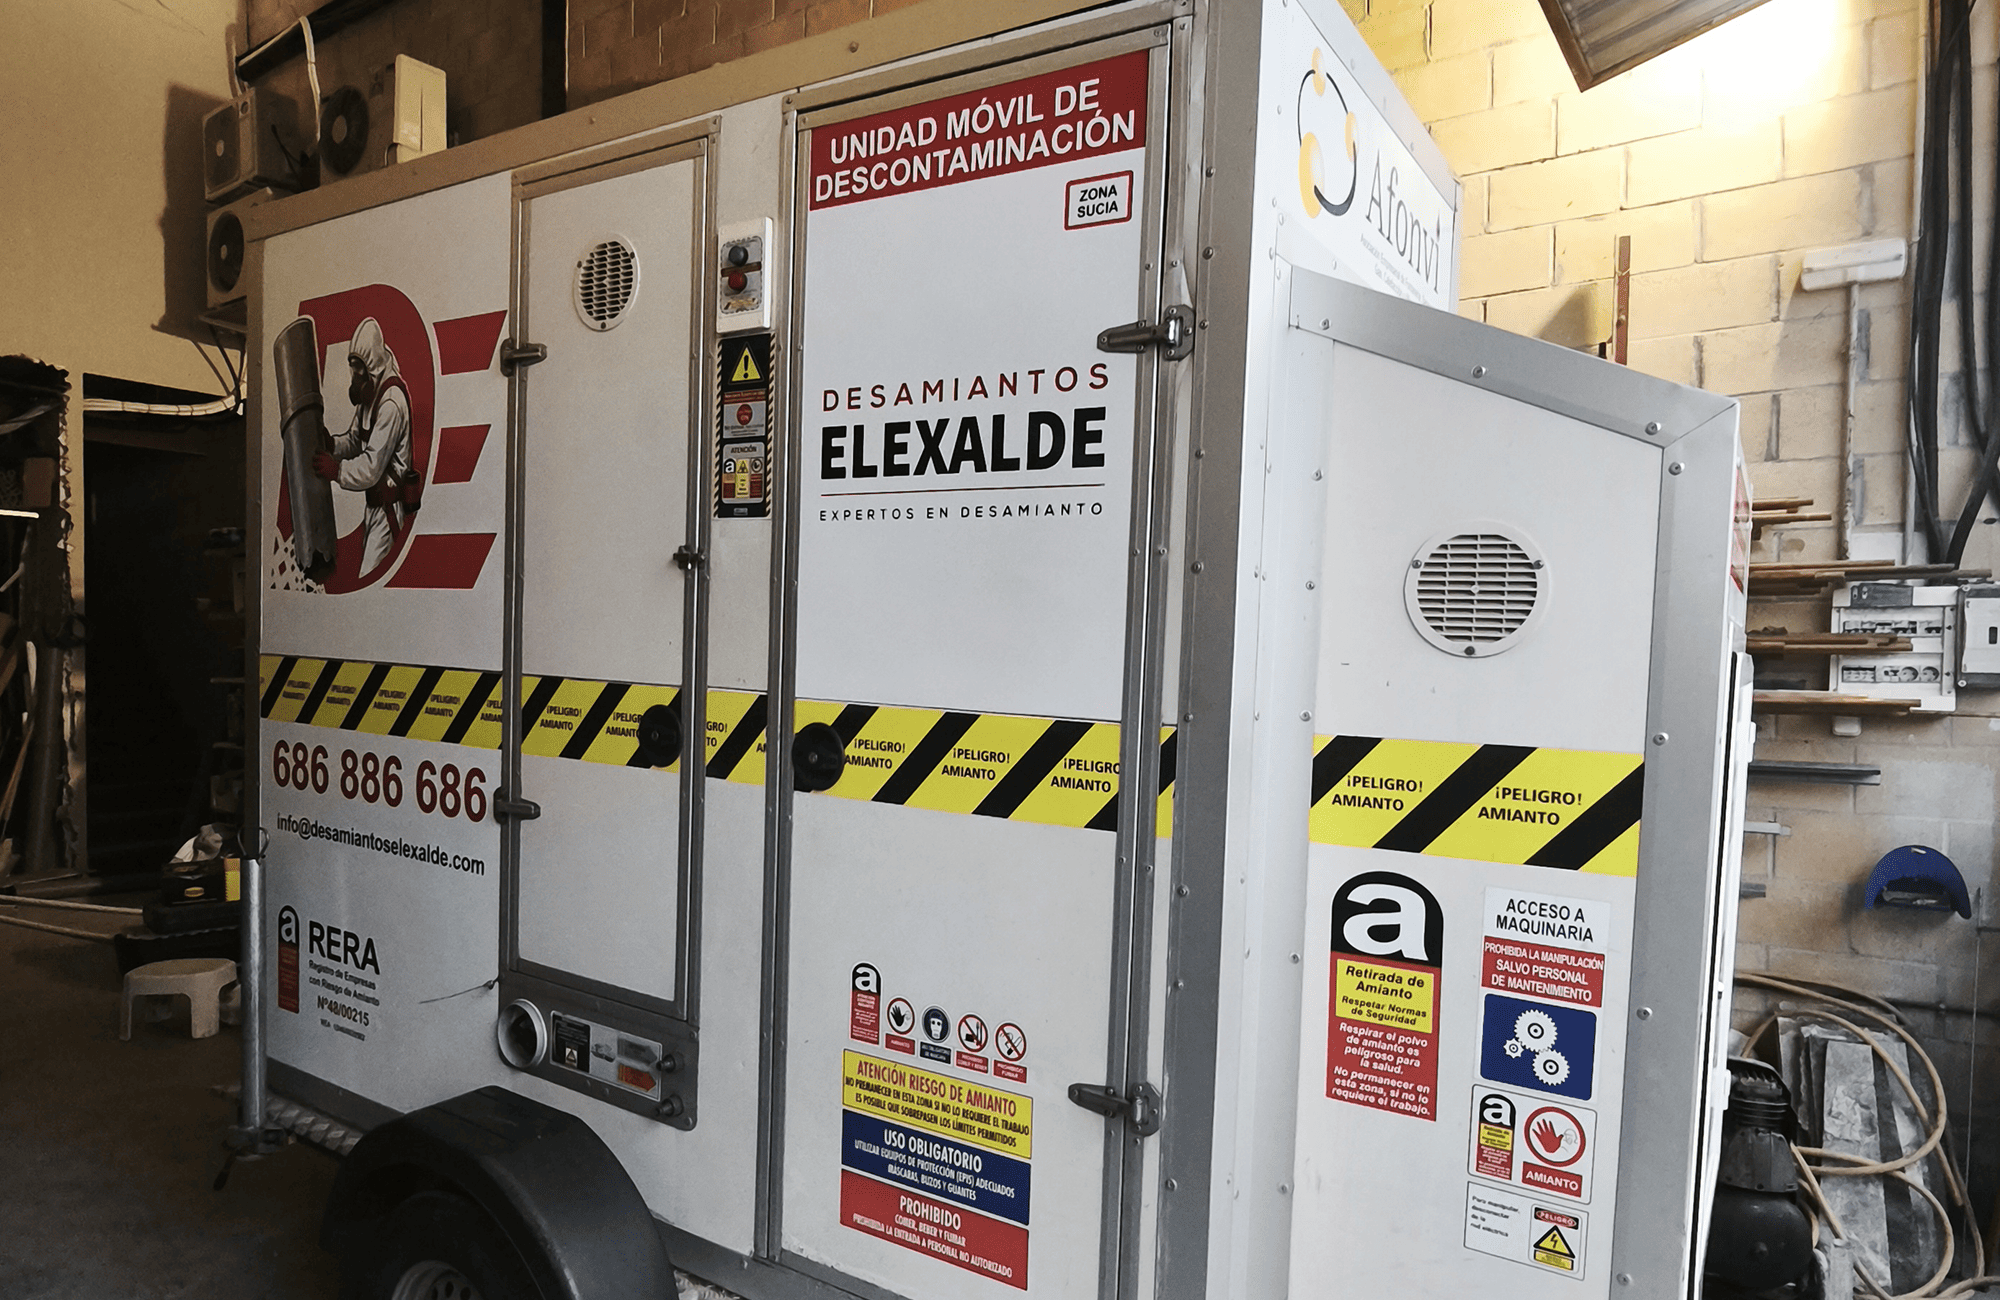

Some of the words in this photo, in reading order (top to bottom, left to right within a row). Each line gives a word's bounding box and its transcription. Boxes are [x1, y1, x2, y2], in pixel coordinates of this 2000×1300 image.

[831, 117, 937, 164] UNIDAD
[947, 94, 1044, 140] MÓVIL
[1055, 78, 1100, 117] DE
[815, 109, 1135, 202] DESCONTAMINACIÓN
[1079, 185, 1118, 202] ZONA
[1077, 201, 1118, 218] SUCIA
[1365, 149, 1440, 294] Afonvi
[823, 363, 1109, 412] DESAMIANTOS
[821, 406, 1106, 479] ELEXALDE
[820, 507, 914, 521] EXPERTOS
[926, 506, 949, 519] EN
[961, 502, 1103, 518] DESAMIANTO
[546, 706, 582, 717] ¡PELIGRO!
[612, 711, 642, 723] ¡PELIGR
[540, 719, 573, 731] AMIANTO
[854, 738, 906, 753] ¡PELIGRO!
[952, 747, 1010, 764] ¡PELIGRO!
[845, 754, 892, 769] AMIANTO
[941, 764, 996, 781] AMIANTO
[1063, 758, 1120, 774] ¡PELIGRO
[273, 739, 329, 794] 686
[340, 749, 403, 807] 886
[416, 760, 487, 822] 686
[1050, 776, 1111, 793] AMIANTO
[1347, 775, 1423, 793] ¡PELIGRO!
[1331, 793, 1404, 811] AMIANTO
[1495, 786, 1582, 806] ¡PELIGRO!
[1477, 806, 1560, 826] AMIANTO
[277, 812, 485, 876] info@desamiantoselexalde.com
[1343, 883, 1429, 961] a
[1506, 898, 1571, 921] ACCESO
[1574, 908, 1585, 923] A
[1496, 914, 1594, 943] MAQUINARIA
[309, 920, 380, 975] RERA
[1484, 941, 1528, 959] PROHIBIDA
[1528, 948, 1540, 961] LA
[1541, 951, 1604, 971] MANIPULACIÓN
[855, 967, 878, 993] a
[1346, 965, 1403, 984] Retirada
[1407, 976, 1424, 988] de
[1496, 958, 1530, 975] SALVO
[1532, 964, 1589, 985] PERSONAL
[1356, 980, 1412, 1000] Amianto
[1491, 973, 1505, 987] DE
[1507, 976, 1592, 1002] MANTENIMIENTO
[1342, 995, 1385, 1010] Respetar
[1388, 1003, 1427, 1017] Normas
[1351, 1007, 1363, 1016] de
[1366, 1009, 1417, 1025] Seguridad
[1340, 1022, 1384, 1038] Respirar
[1386, 1032, 1396, 1041] el
[1398, 1035, 1428, 1047] polvo
[1346, 1035, 1359, 1045] de
[1362, 1039, 1404, 1053] amianto
[1406, 1047, 1420, 1056] es
[1344, 1046, 1394, 1061] peligroso
[1396, 1056, 1420, 1067] para
[1360, 1058, 1369, 1067] la
[1372, 1062, 1403, 1074] salud.
[857, 1060, 906, 1087] ATENCIÓN
[909, 1073, 946, 1098] RIESGO
[950, 1084, 963, 1103] DE
[966, 1089, 1016, 1117] AMIANTO
[1334, 1065, 1348, 1076] No
[1350, 1070, 1414, 1090] permanecer
[1416, 1084, 1430, 1094] en
[1334, 1078, 1357, 1088] esta
[1359, 1083, 1386, 1096] zona,
[1389, 1089, 1399, 1098] si
[1401, 1091, 1415, 1101] no
[1418, 1094, 1429, 1104] lo
[846, 1076, 854, 1086] NO
[893, 1089, 900, 1099] EN
[902, 1092, 914, 1104] ESTA
[916, 1096, 933, 1109] ZONA
[934, 1101, 939, 1110] SI
[941, 1103, 950, 1114] NO
[952, 1106, 960, 1116] LO
[962, 1108, 991, 1125] REQUIERE
[993, 1117, 999, 1127] EL
[1001, 1119, 1029, 1136] TRABAJO
[1332, 1087, 1375, 1103] requiere
[1377, 1097, 1388, 1106] el
[1390, 1099, 1430, 1115] trabajo.
[1483, 1097, 1511, 1126] a
[856, 1093, 862, 1103] ES
[863, 1095, 886, 1110] POSIBLE
[887, 1102, 899, 1114] QUE
[901, 1105, 938, 1125] SOBREPASEN
[940, 1117, 951, 1128] LOS
[952, 1117, 976, 1136] LÍMITES
[977, 1127, 1016, 1147] PERMITIDOS
[884, 1128, 906, 1150] USO
[908, 1136, 982, 1173] OBLIGATORIO
[854, 1139, 880, 1156] UTILIZAR
[881, 1147, 907, 1164] EQUIPOS
[907, 1155, 916, 1167] DE
[917, 1158, 955, 1179] PROTECCIÓN
[956, 1171, 974, 1188] (EPIS)
[976, 1177, 1015, 1198] ADECUADOS
[1525, 1170, 1579, 1191] AMIANTO
[921, 1174, 941, 1189] BUZOS
[942, 1181, 947, 1191] Y
[948, 1182, 977, 1201] GUANTES
[900, 1195, 961, 1230] PROHIBIDO
[1540, 1211, 1574, 1226] PELIGRO
[894, 1213, 918, 1232] COMER,
[919, 1221, 937, 1237] BEBER
[939, 1228, 943, 1238] Y
[943, 1230, 966, 1247] FUMAR
[853, 1212, 884, 1232] PROHIBIDA
[885, 1225, 893, 1236] LA
[894, 1227, 920, 1245] ENTRADA
[921, 1237, 926, 1247] A
[927, 1239, 958, 1259] PERSONAL
[959, 1250, 969, 1262] NO
[970, 1254, 1013, 1278] AUTORIZADO
